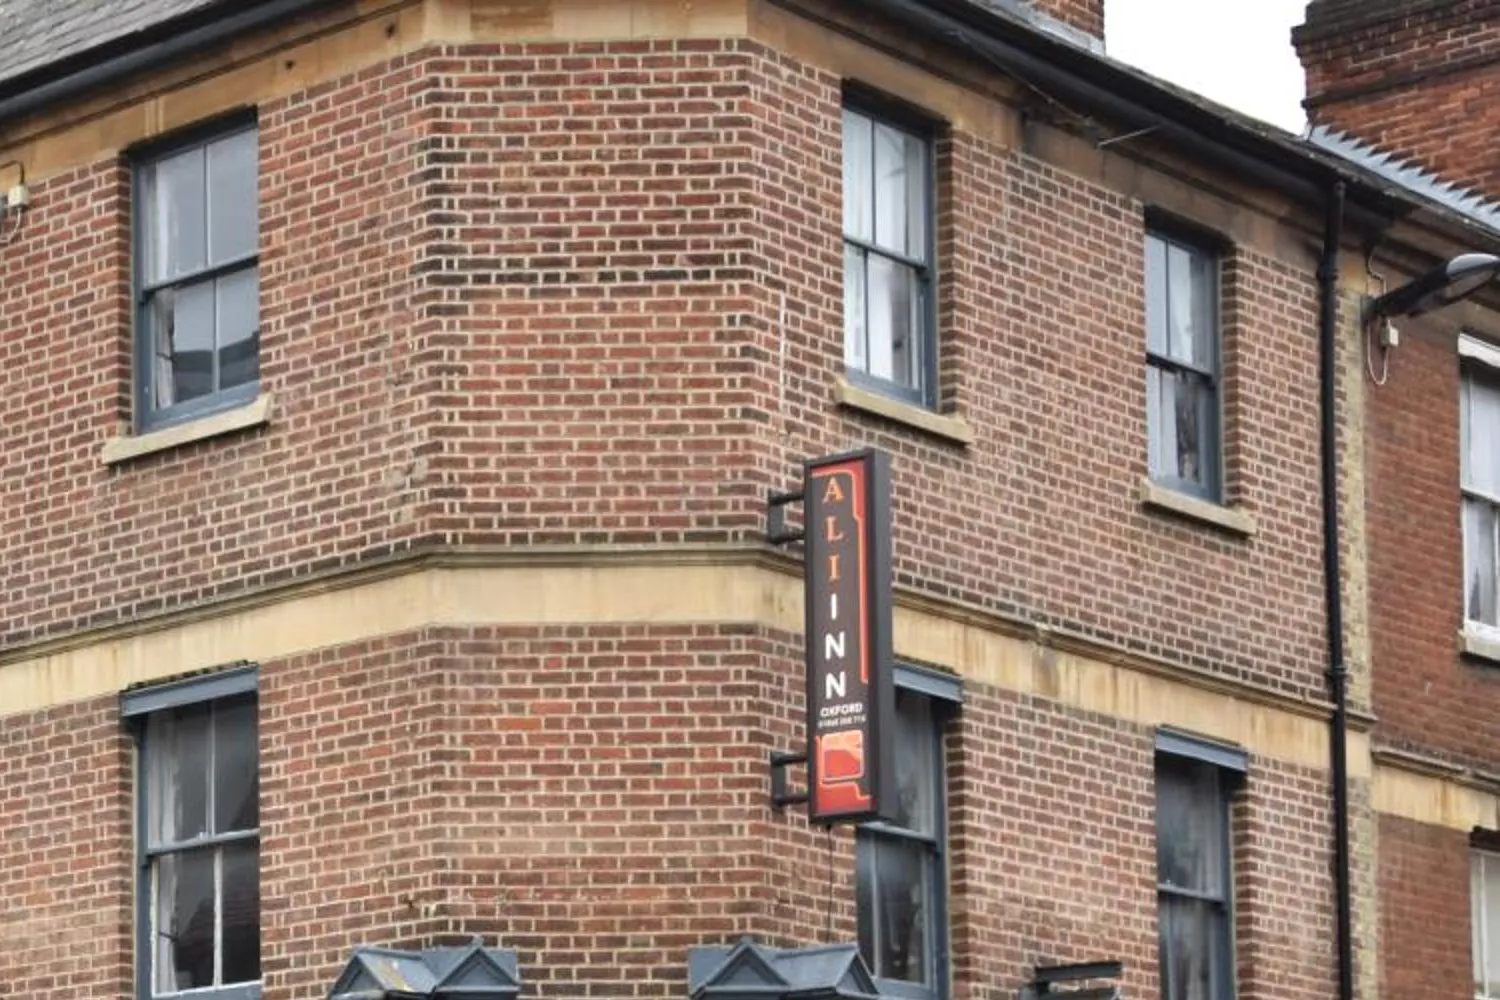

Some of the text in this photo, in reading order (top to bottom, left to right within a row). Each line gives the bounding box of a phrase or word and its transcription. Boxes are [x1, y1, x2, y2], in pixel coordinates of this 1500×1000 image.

[822, 477, 847, 699] ALI INN
[820, 702, 863, 717] OXFORD
